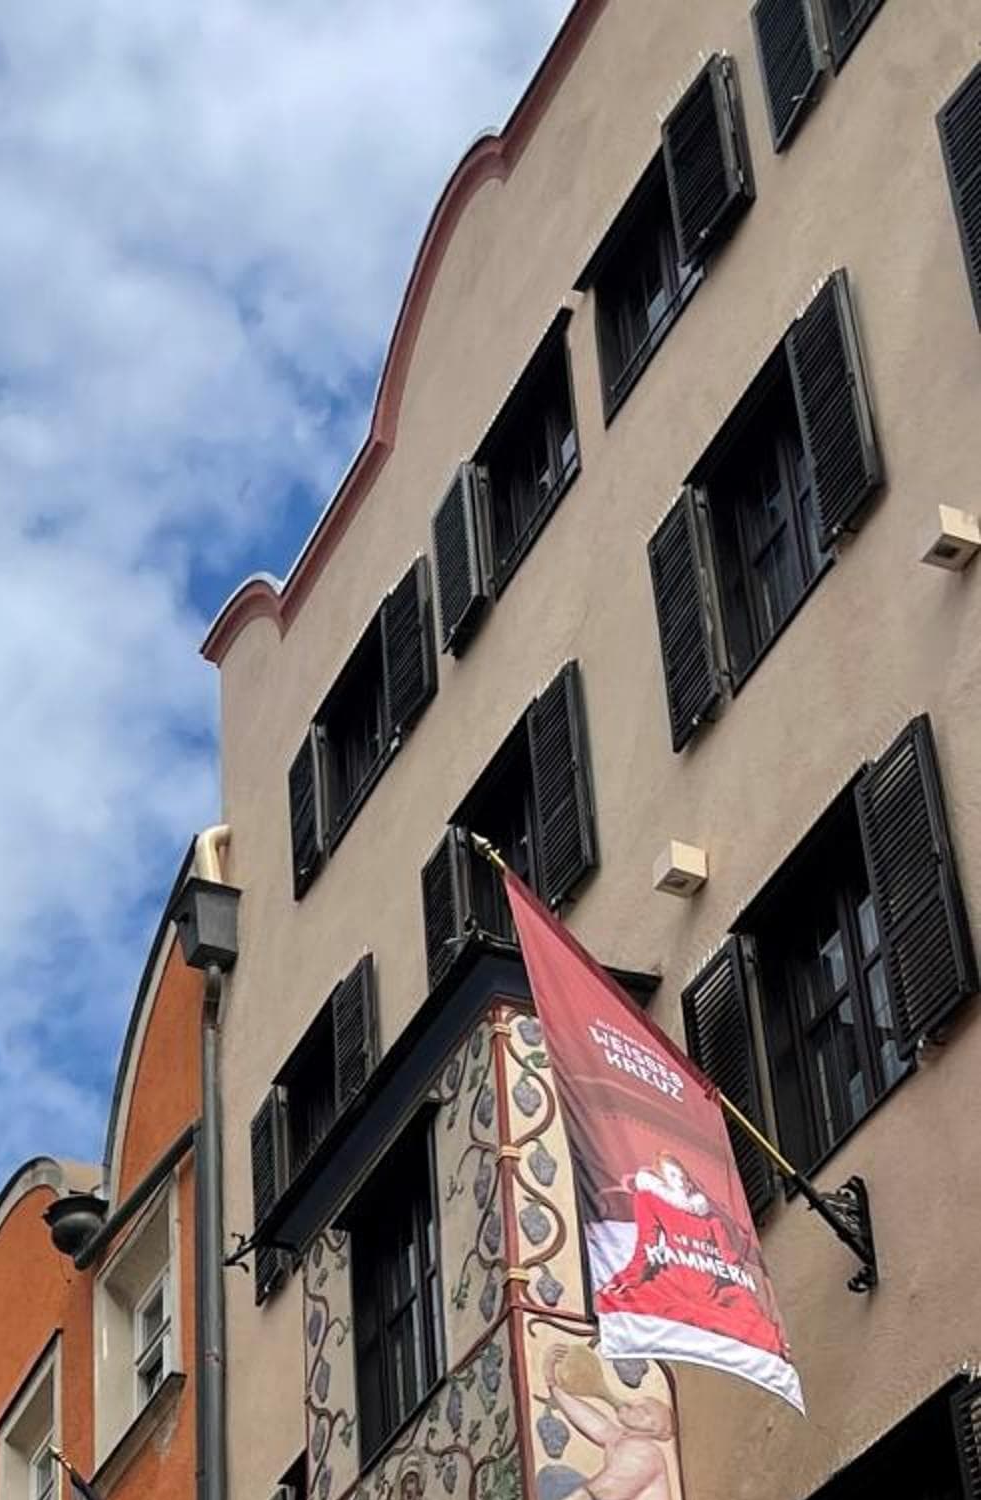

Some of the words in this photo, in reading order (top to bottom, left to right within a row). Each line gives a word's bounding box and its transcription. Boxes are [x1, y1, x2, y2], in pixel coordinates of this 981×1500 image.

[588, 1025, 683, 1089] WEISSES
[604, 1048, 684, 1103] KREUZ
[644, 1230, 757, 1292] KAMMERN
